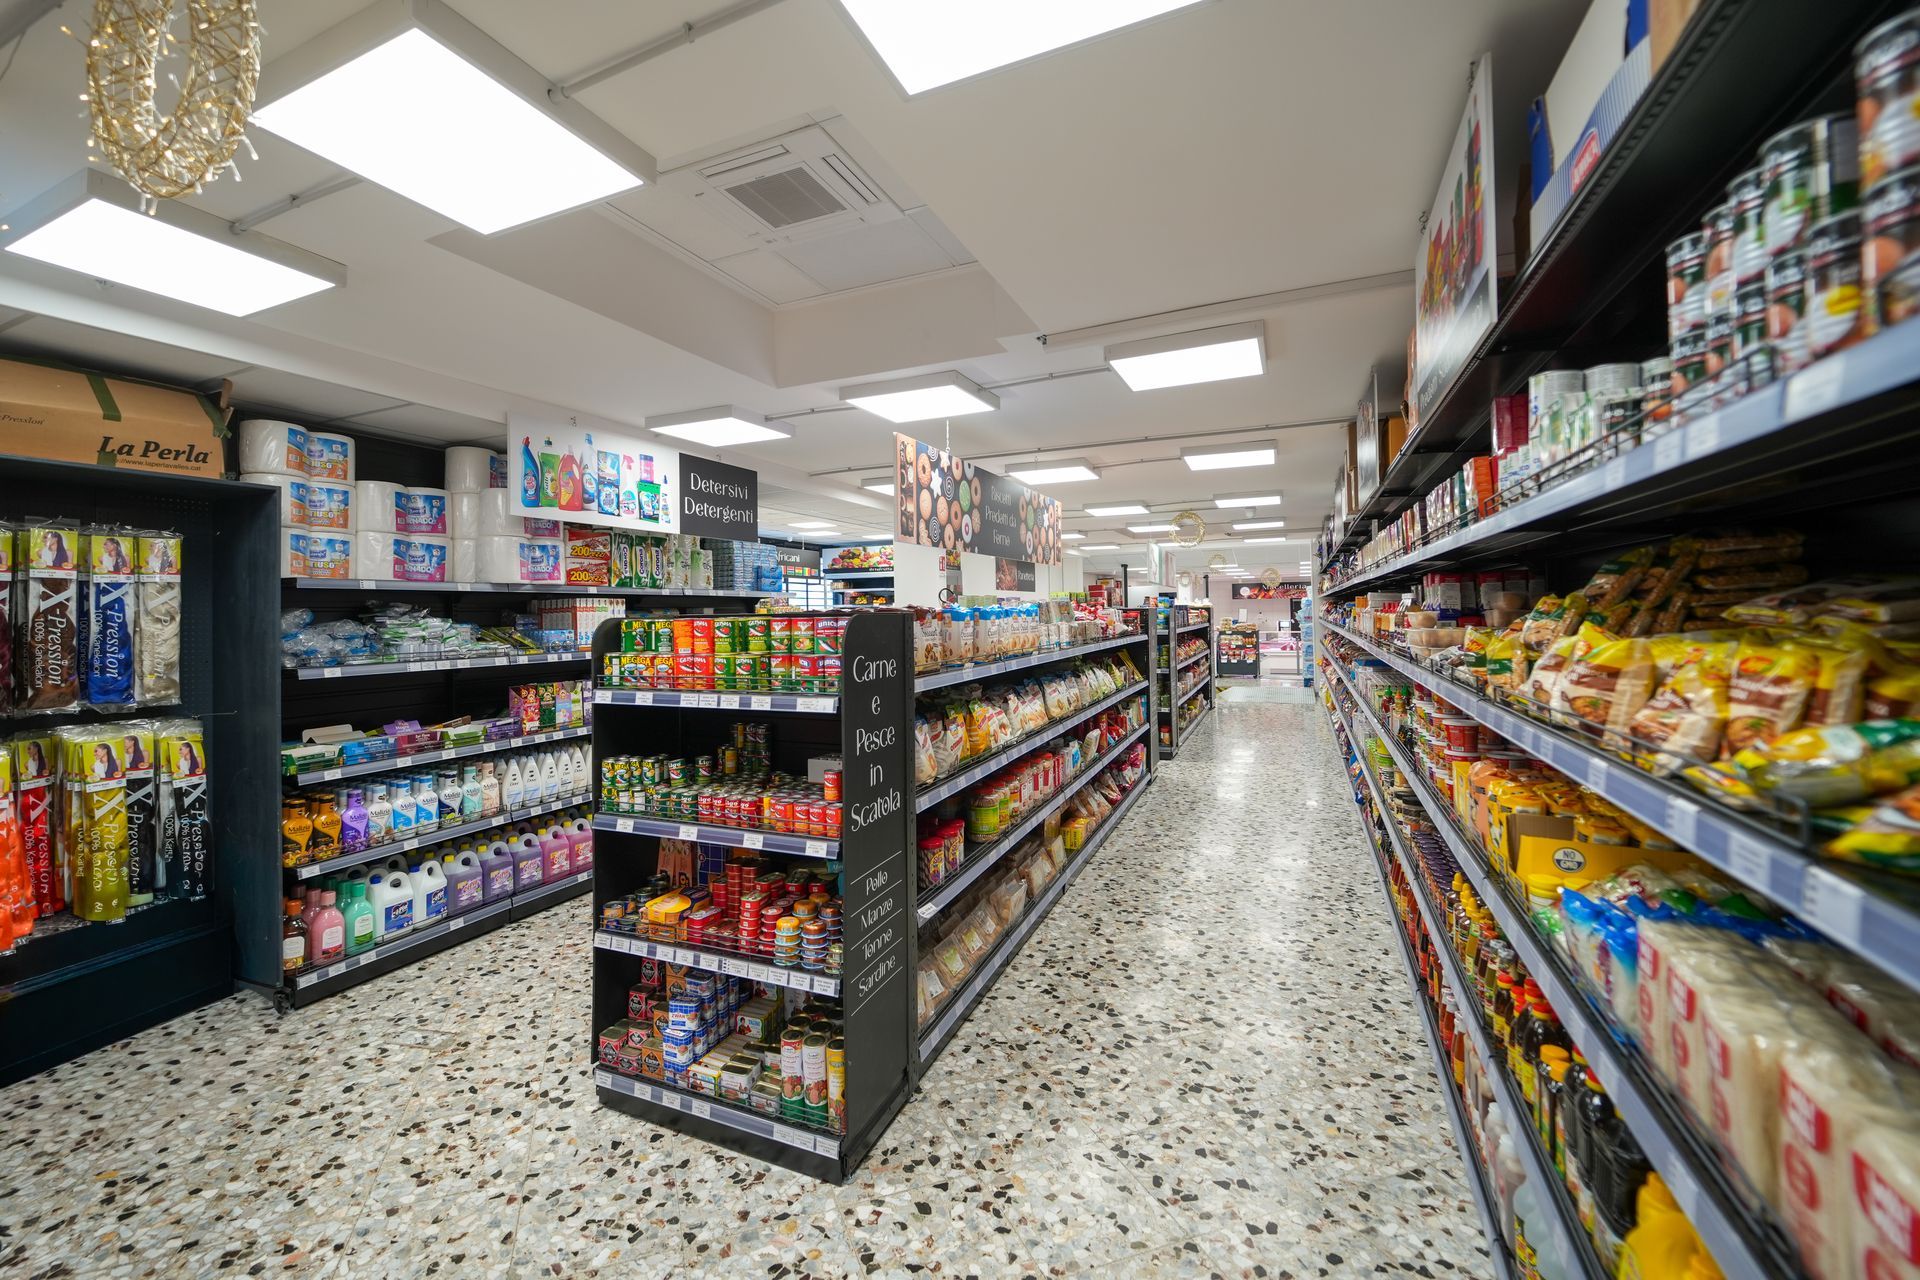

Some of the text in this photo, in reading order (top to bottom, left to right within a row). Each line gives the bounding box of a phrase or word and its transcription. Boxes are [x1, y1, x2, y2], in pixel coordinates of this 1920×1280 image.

[97, 436, 209, 464] La Perla
[690, 472, 748, 500] Detersivi
[684, 496, 754, 524] Detergenti
[571, 546, 590, 558] 200
[777, 550, 801, 562] fricani
[570, 571, 589, 582] 200
[34, 617, 45, 688] 100% Kanekalon
[621, 656, 638, 666] MEG
[638, 656, 652, 667] EGA
[853, 655, 897, 683] Carne
[871, 696, 881, 715] e
[856, 726, 896, 756] Pesce
[870, 763, 883, 787] in
[851, 787, 901, 832] Scatola
[1562, 850, 1576, 860] NO
[866, 871, 888, 896] Pollo
[861, 898, 893, 932] Manzo
[862, 928, 893, 961] Tonno
[858, 955, 896, 998] Sardine
